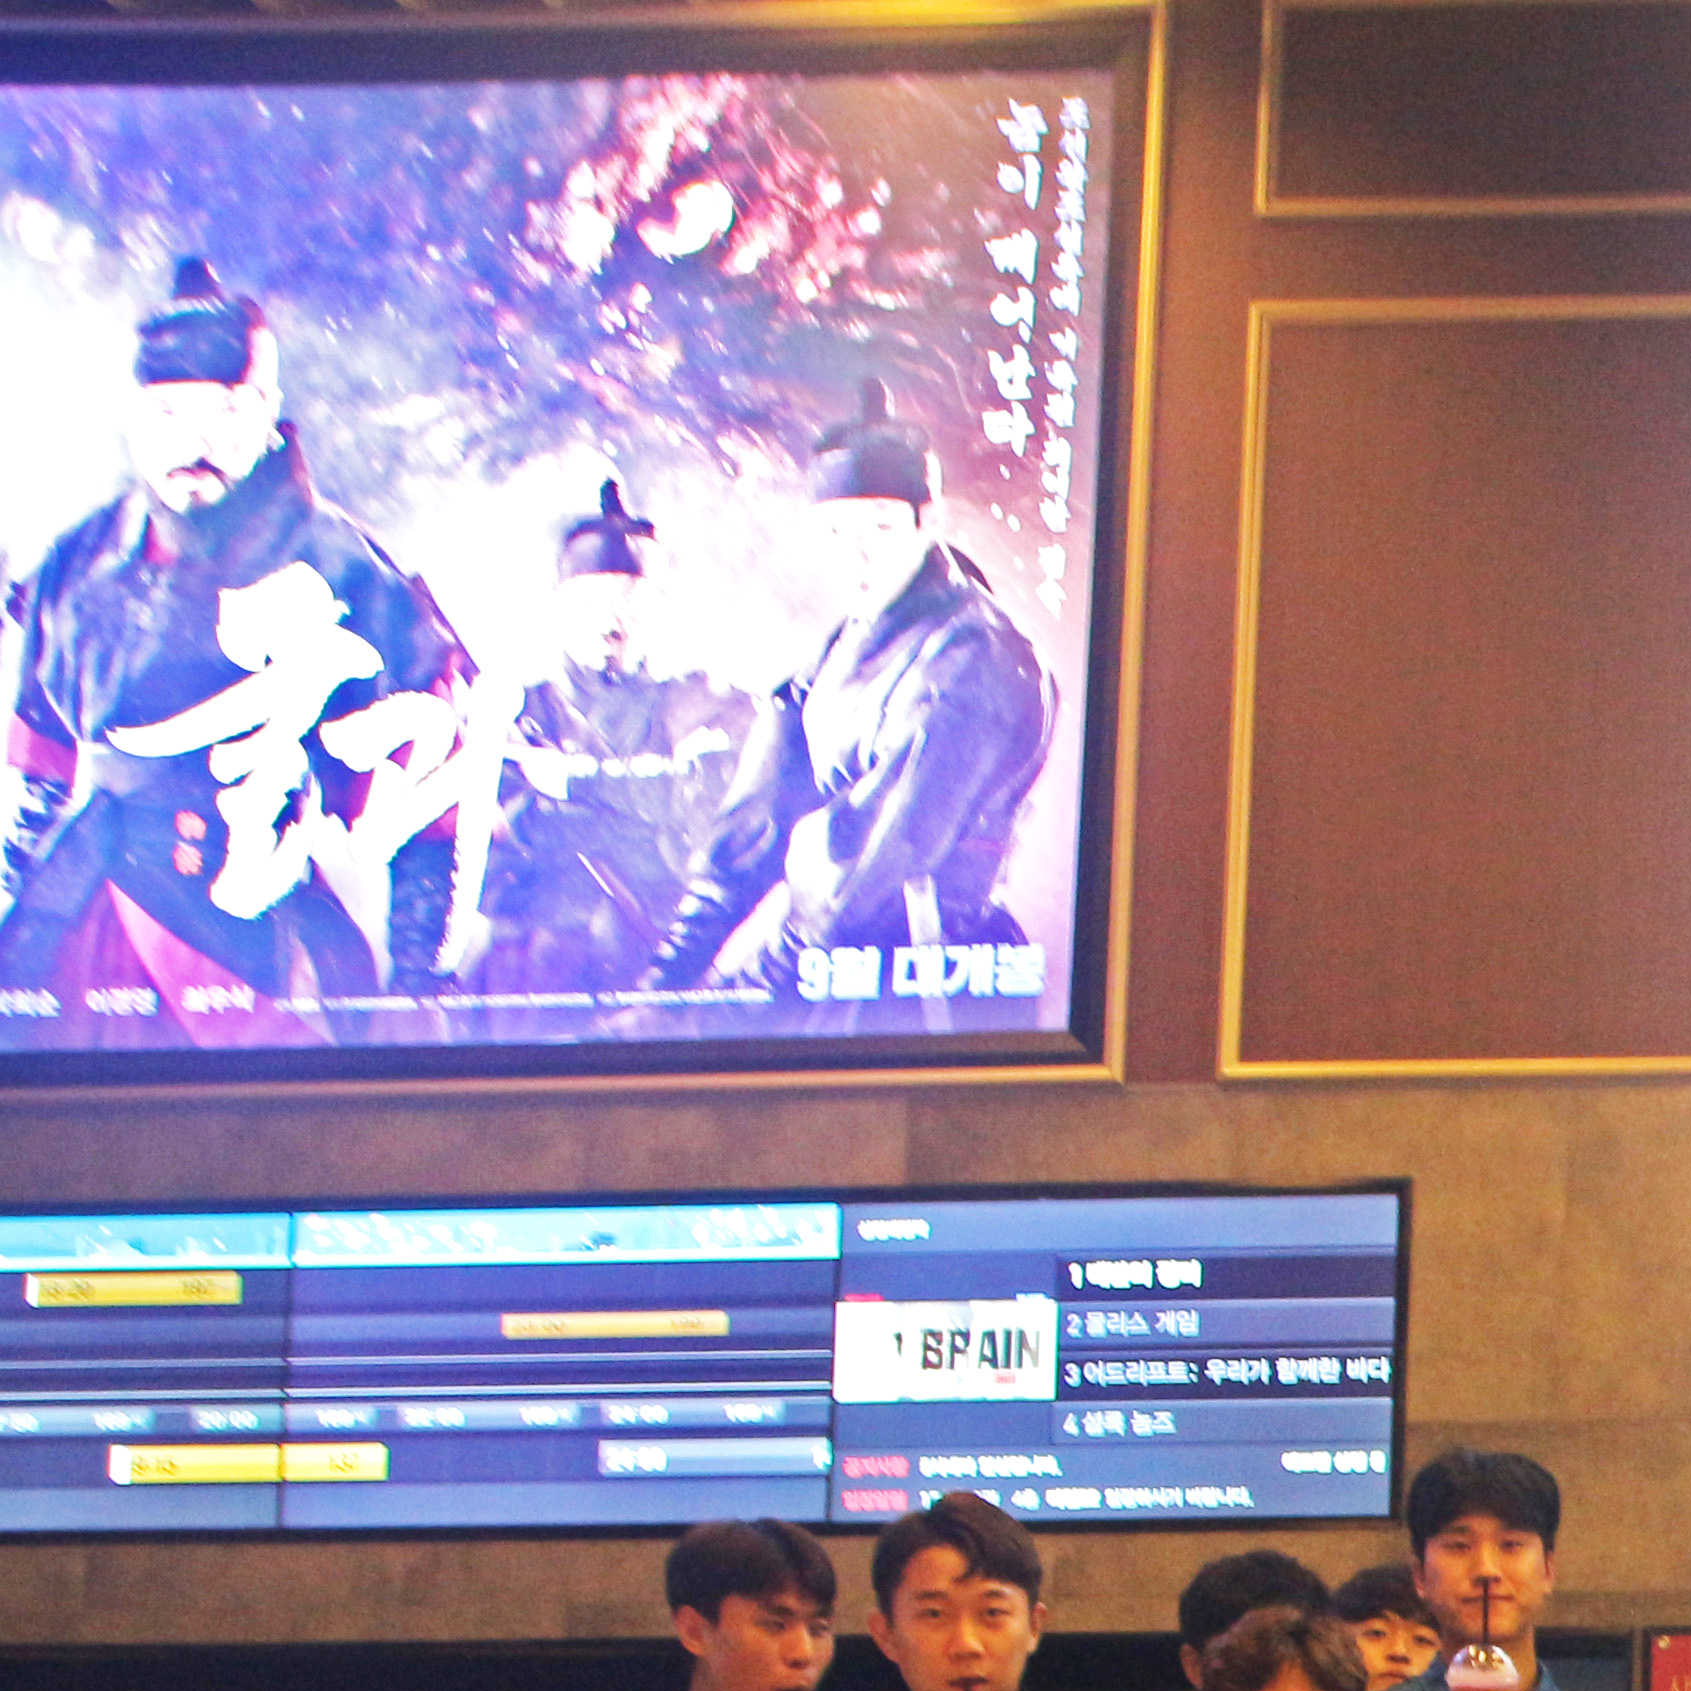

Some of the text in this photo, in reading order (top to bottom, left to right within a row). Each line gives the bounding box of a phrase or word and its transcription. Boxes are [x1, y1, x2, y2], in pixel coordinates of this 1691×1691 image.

[798, 943, 1046, 1001] 9월 대개봉
[1066, 1313, 1083, 1337] 2
[1064, 1365, 1081, 1388] 3
[1203, 1359, 1271, 1384] 우리가
[1346, 1356, 1391, 1382] 바다
